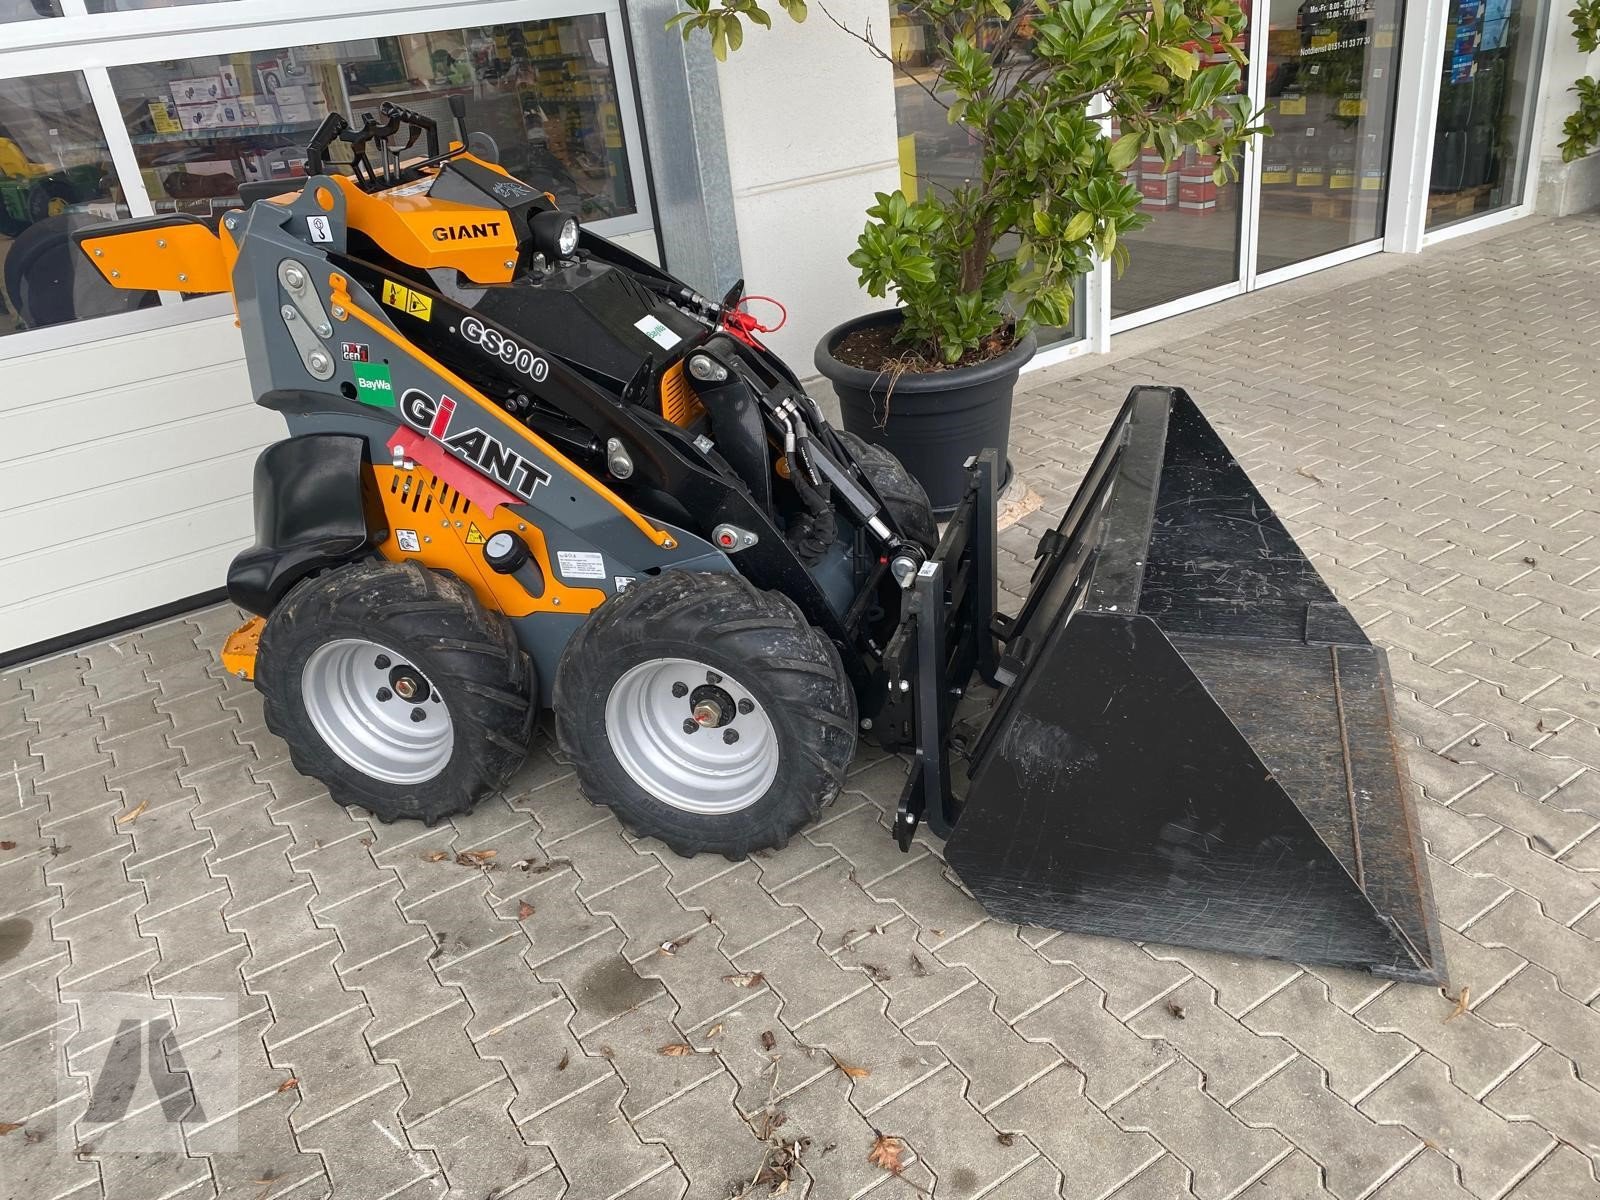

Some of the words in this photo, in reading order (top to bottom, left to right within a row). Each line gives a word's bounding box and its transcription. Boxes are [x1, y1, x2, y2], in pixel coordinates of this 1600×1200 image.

[1326, 10, 1339, 19] 13.00
[1300, 44, 1327, 56] Notdienst
[1349, 39, 1356, 48] 33
[1356, 37, 1363, 46] 77
[433, 222, 501, 241] GIANT
[460, 316, 549, 382] GS900
[358, 377, 391, 391] BayWa
